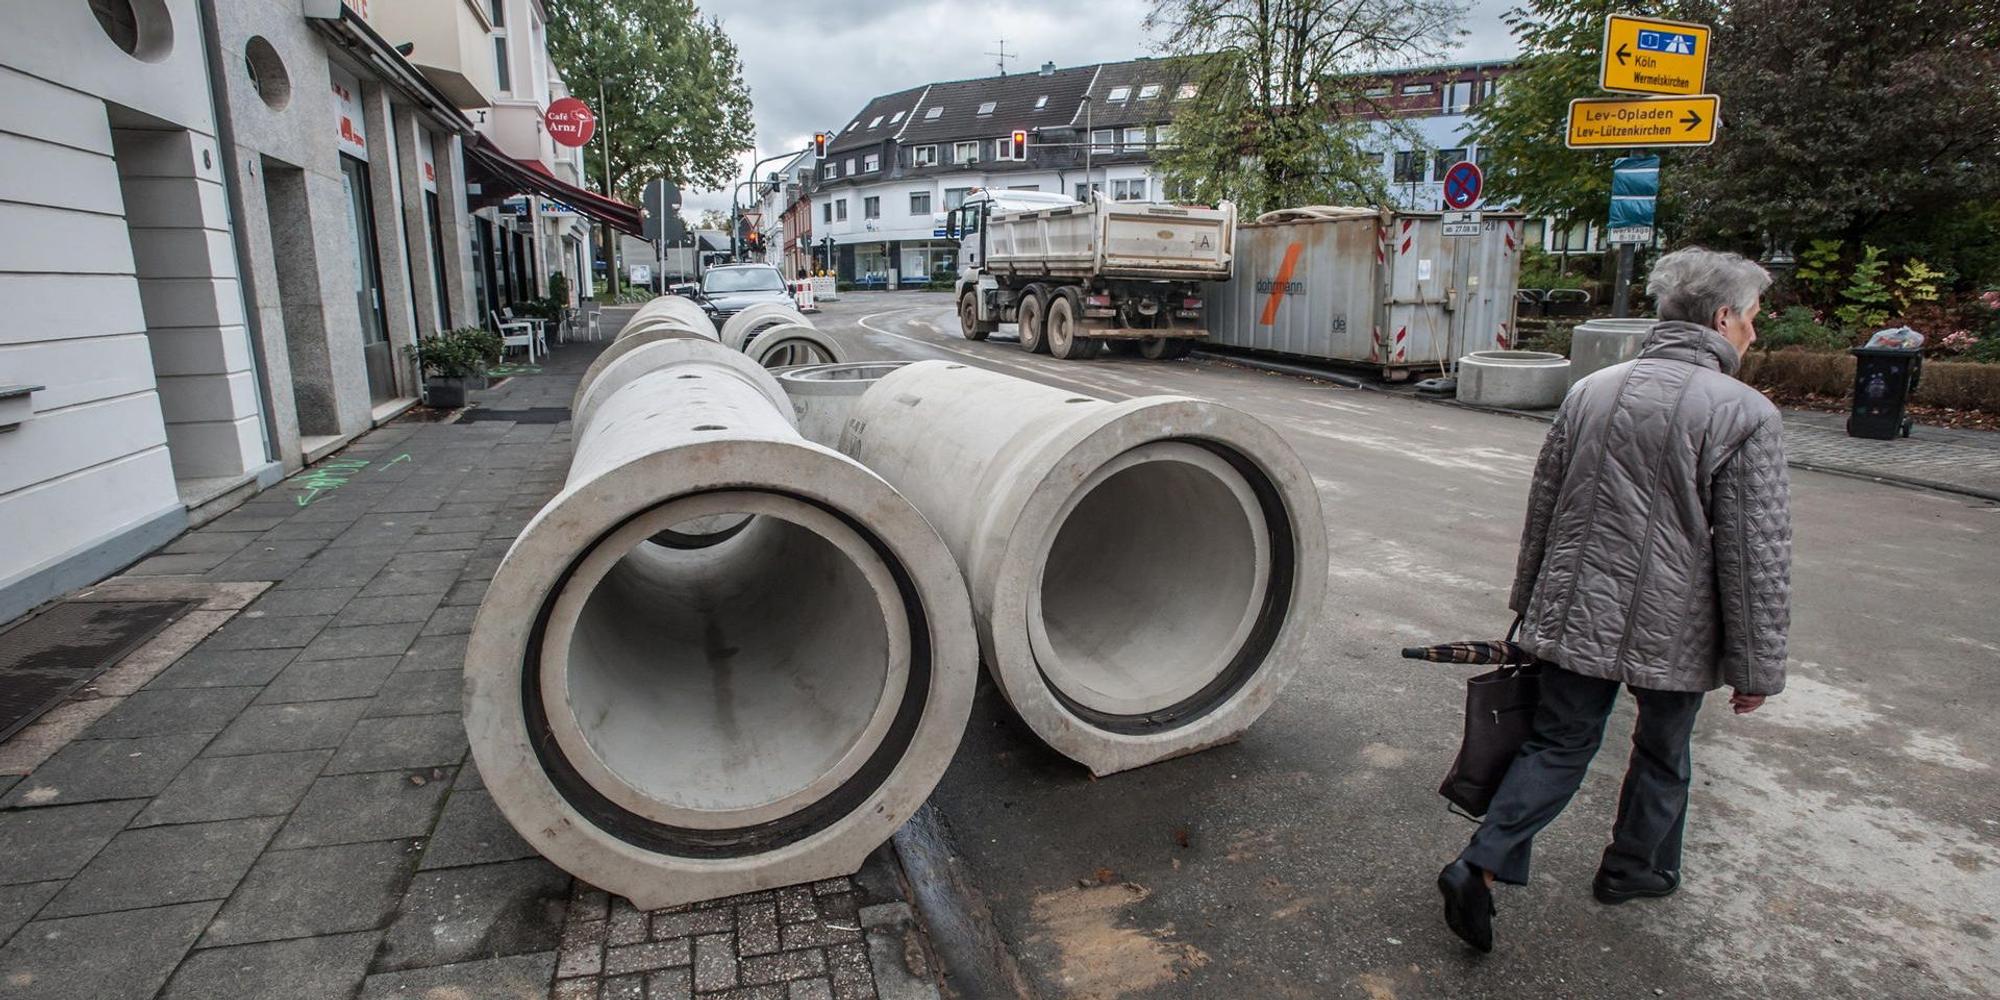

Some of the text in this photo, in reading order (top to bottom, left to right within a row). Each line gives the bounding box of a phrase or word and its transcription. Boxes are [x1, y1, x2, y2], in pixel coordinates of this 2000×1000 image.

[1635, 55, 1657, 68] Köln
[1634, 71, 1690, 89] Wermelskirchen
[547, 112, 568, 121] Café
[1586, 108, 1673, 122] Lev-Opladen
[549, 121, 577, 132] Arnz
[1576, 124, 1672, 138] Lev-Lützenkirchen
[203, 149, 211, 170] 8
[1200, 235, 1210, 249] A
